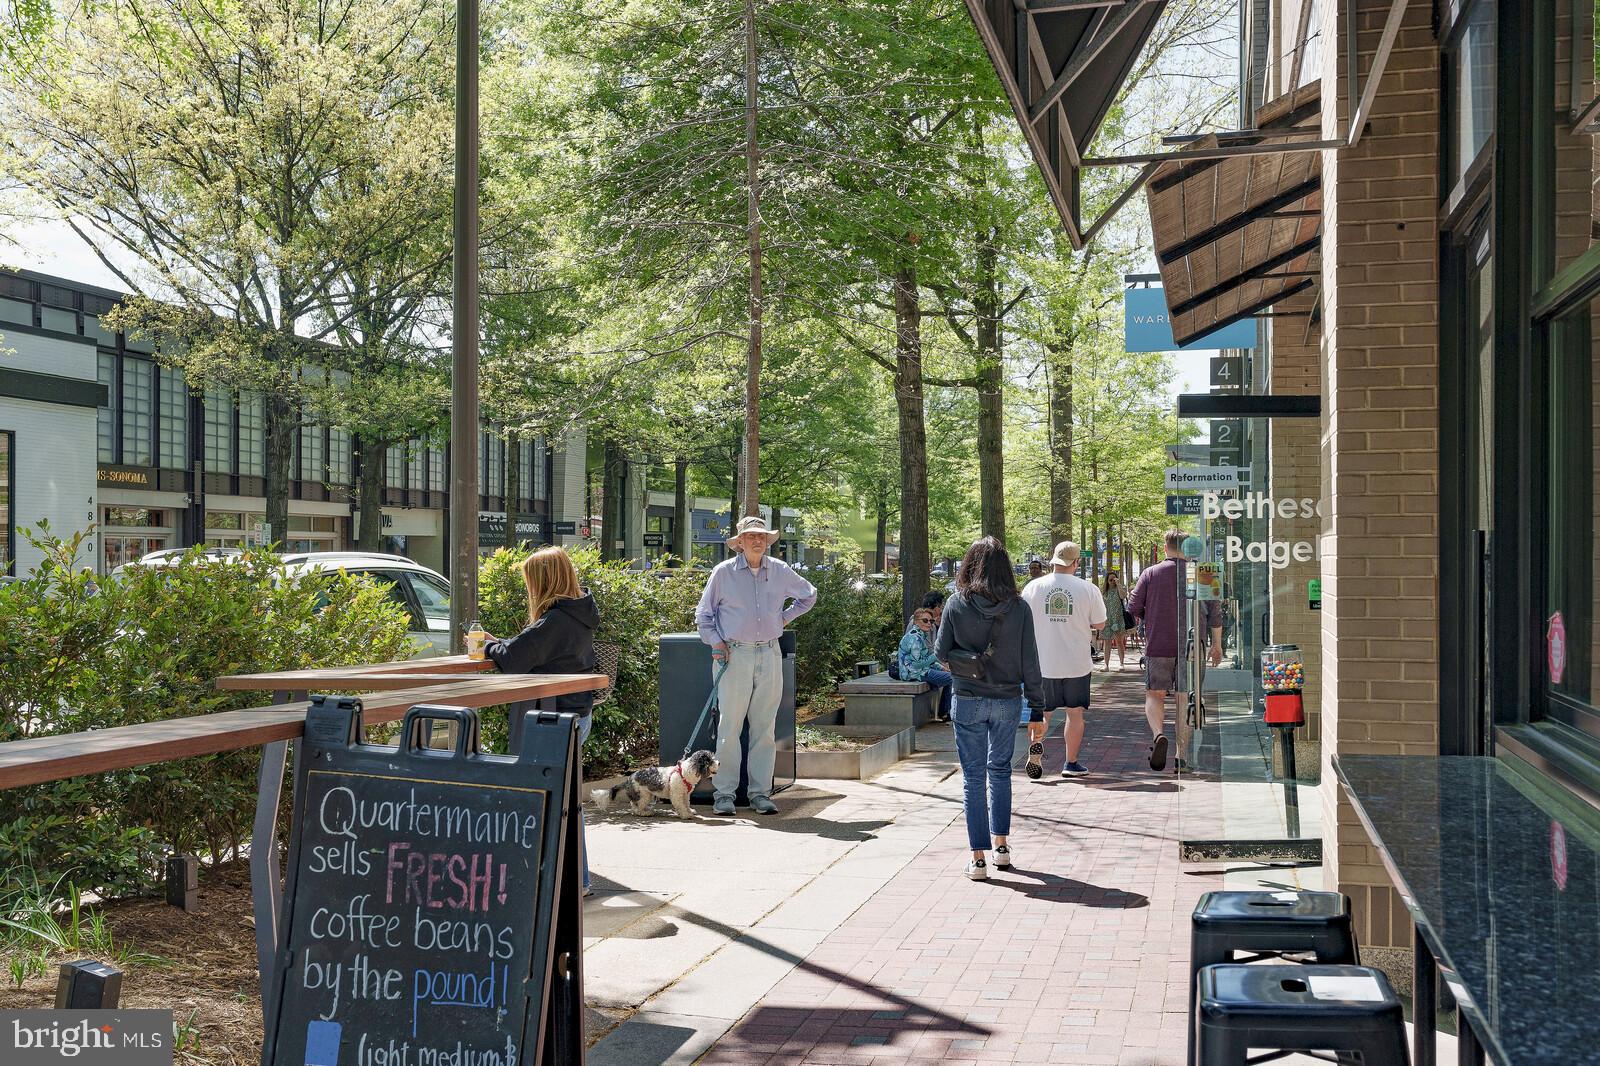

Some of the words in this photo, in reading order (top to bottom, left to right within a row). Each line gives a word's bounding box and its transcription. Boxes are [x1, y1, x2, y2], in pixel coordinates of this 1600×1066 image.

[1133, 314, 1170, 323] WAR
[1170, 473, 1232, 482] Reformation
[320, 787, 536, 848] Quartermaine
[309, 841, 371, 876] sells
[386, 842, 508, 912] FRESH!
[310, 894, 402, 948] coffee
[415, 906, 514, 959] beans
[303, 948, 342, 1021] by
[348, 953, 403, 1000] the
[413, 961, 509, 1038] pound!
